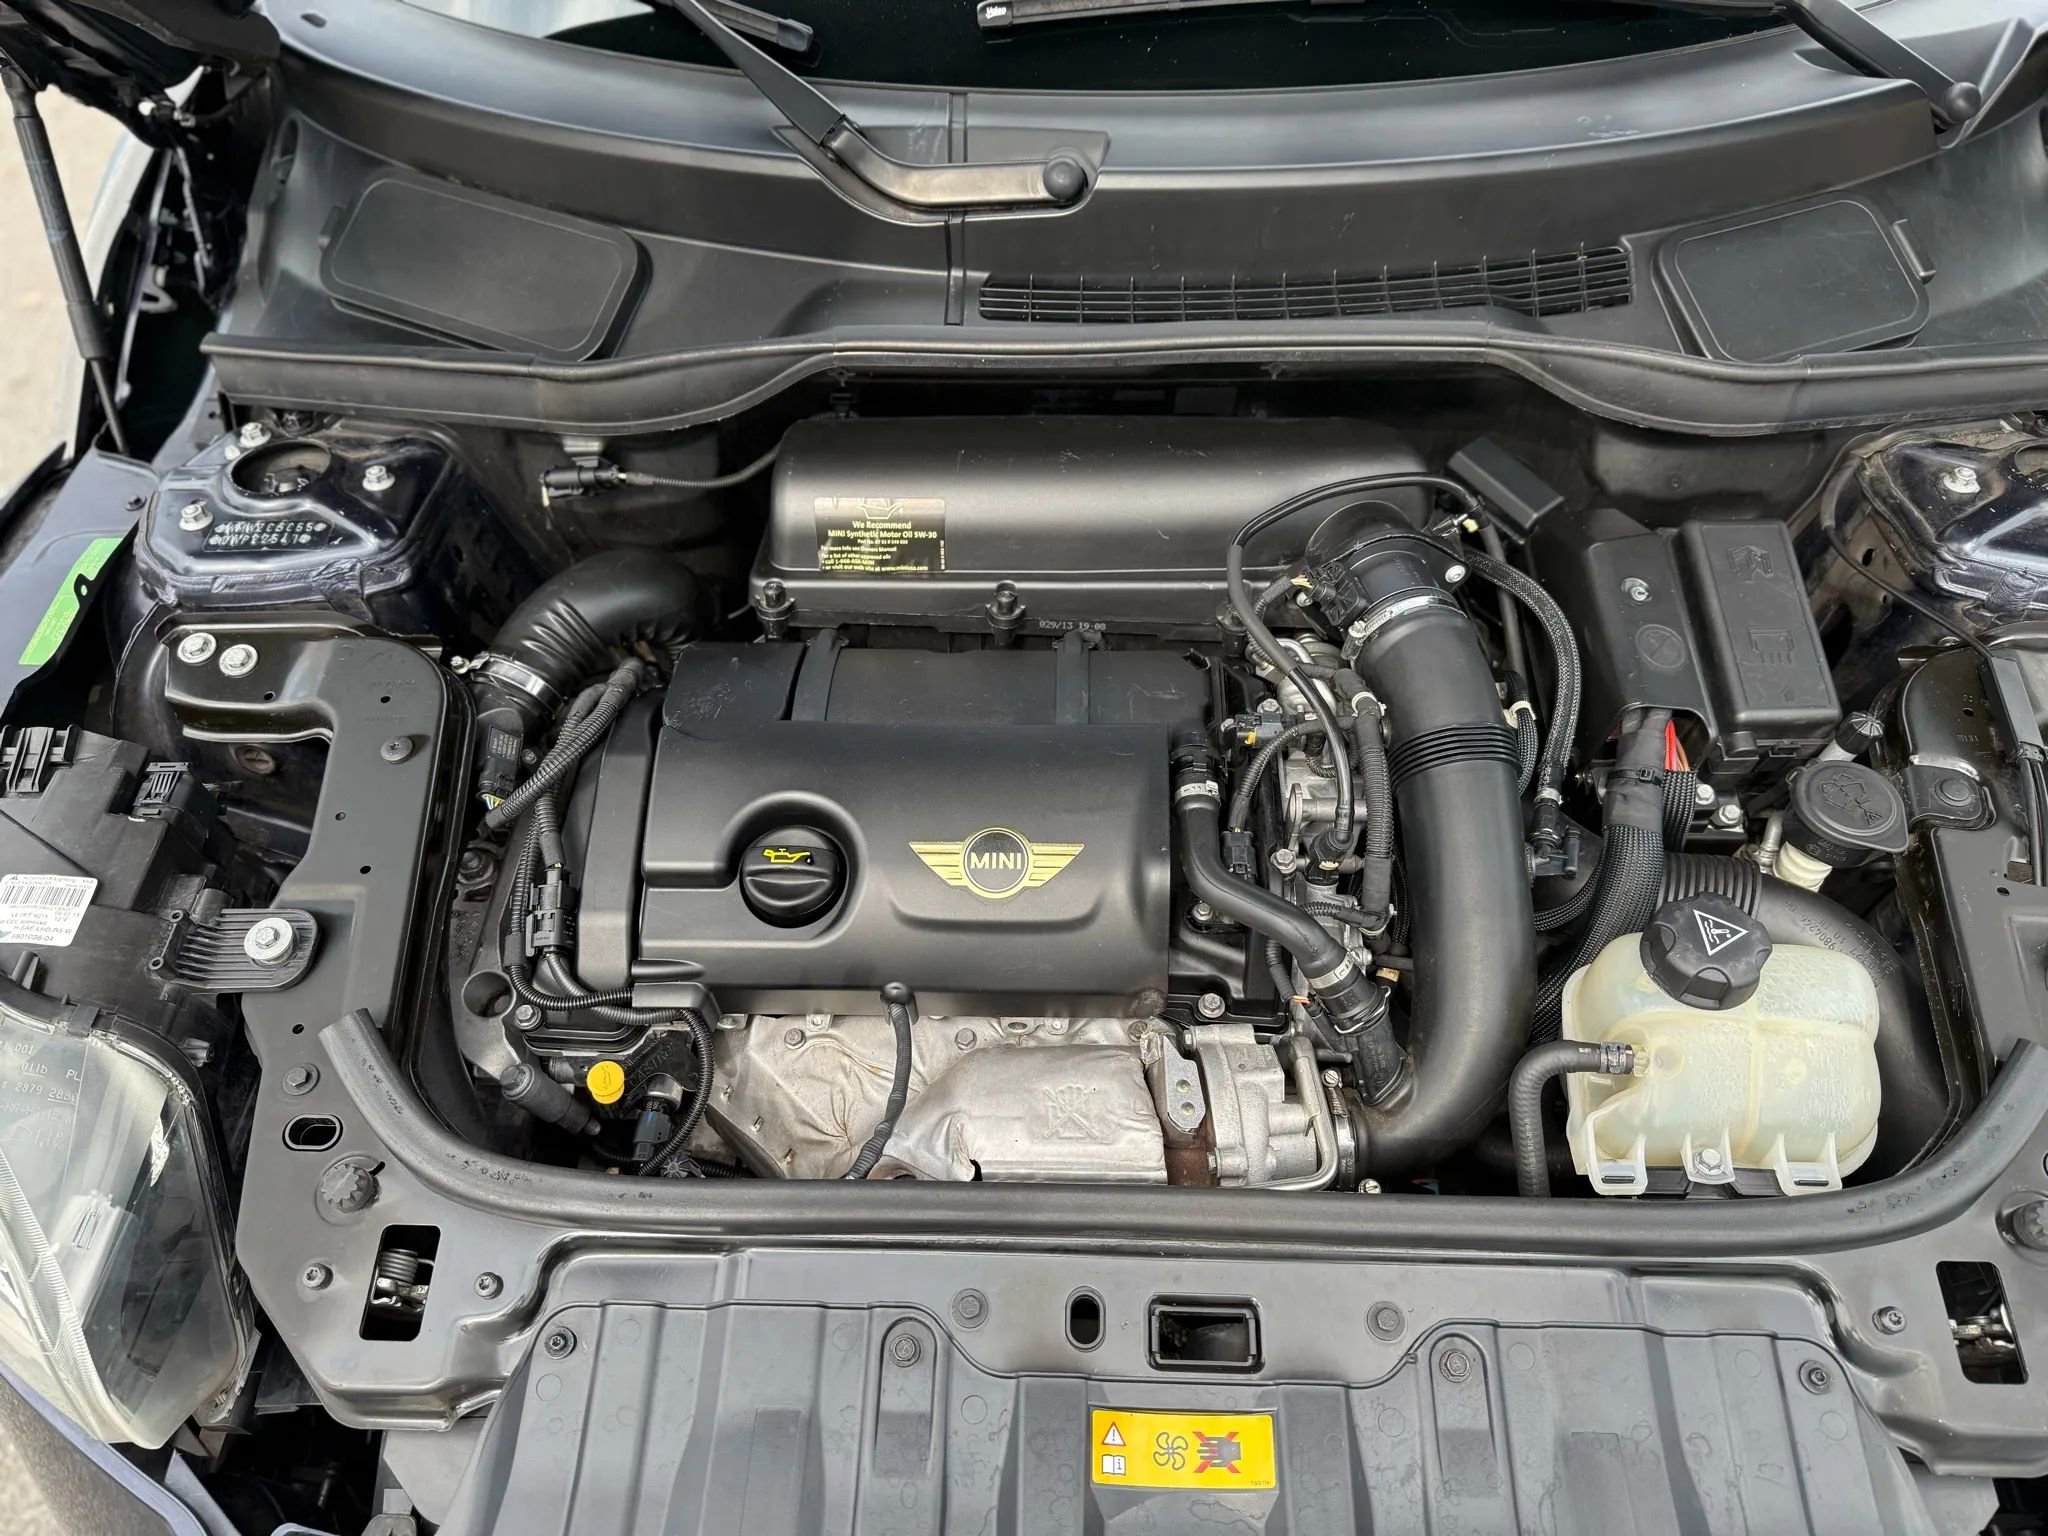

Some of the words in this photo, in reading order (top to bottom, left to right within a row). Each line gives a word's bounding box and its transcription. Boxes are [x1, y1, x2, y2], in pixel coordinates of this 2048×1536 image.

[985, 6, 1007, 19] Valeo
[852, 521, 865, 529] We
[866, 521, 911, 529] Recommend
[847, 530, 879, 540] Synthetic
[879, 531, 901, 539] Motor
[902, 531, 913, 539] Oil
[1039, 620, 1073, 629] 029/13
[971, 852, 1022, 870] MINI
[15, 1043, 34, 1056] 001
[66, 1069, 81, 1082] PL
[15, 1082, 43, 1096] 2879
